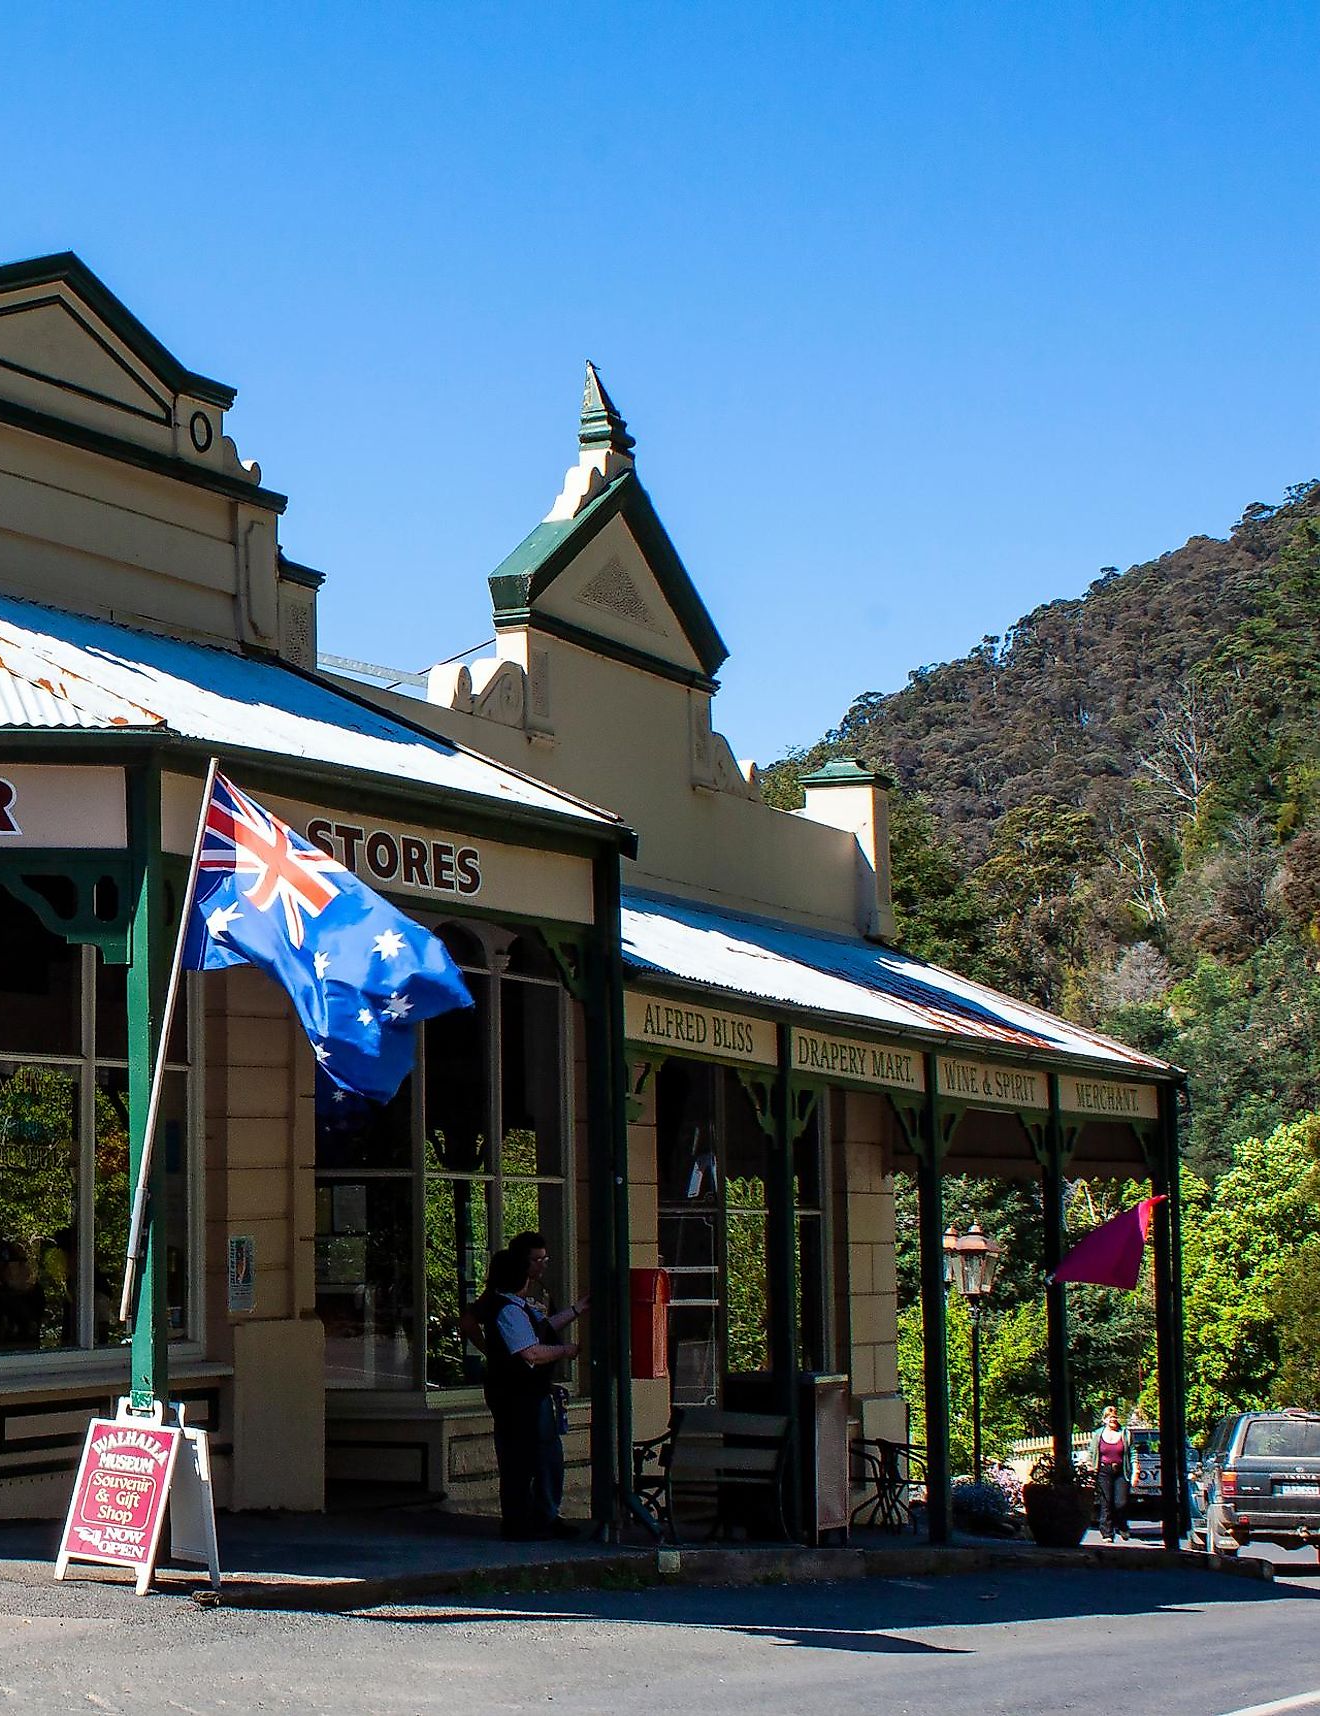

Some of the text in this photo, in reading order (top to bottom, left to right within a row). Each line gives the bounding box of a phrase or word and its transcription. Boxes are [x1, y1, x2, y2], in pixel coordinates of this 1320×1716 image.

[306, 817, 482, 897] STORES
[644, 1003, 754, 1053] ALFRED BLISS
[798, 1036, 915, 1083] DRAPERY MART.
[943, 1060, 1036, 1102] WINE & SPIRIT
[1075, 1082, 1140, 1112] MERCHANT.
[91, 1430, 170, 1467] WALHALLA
[98, 1452, 155, 1475] MUSEUM
[92, 1473, 153, 1495] Souvenir
[95, 1488, 141, 1510] & Gift
[97, 1505, 133, 1526] Shop
[104, 1527, 146, 1544] NOW
[97, 1541, 146, 1559] OPEN
